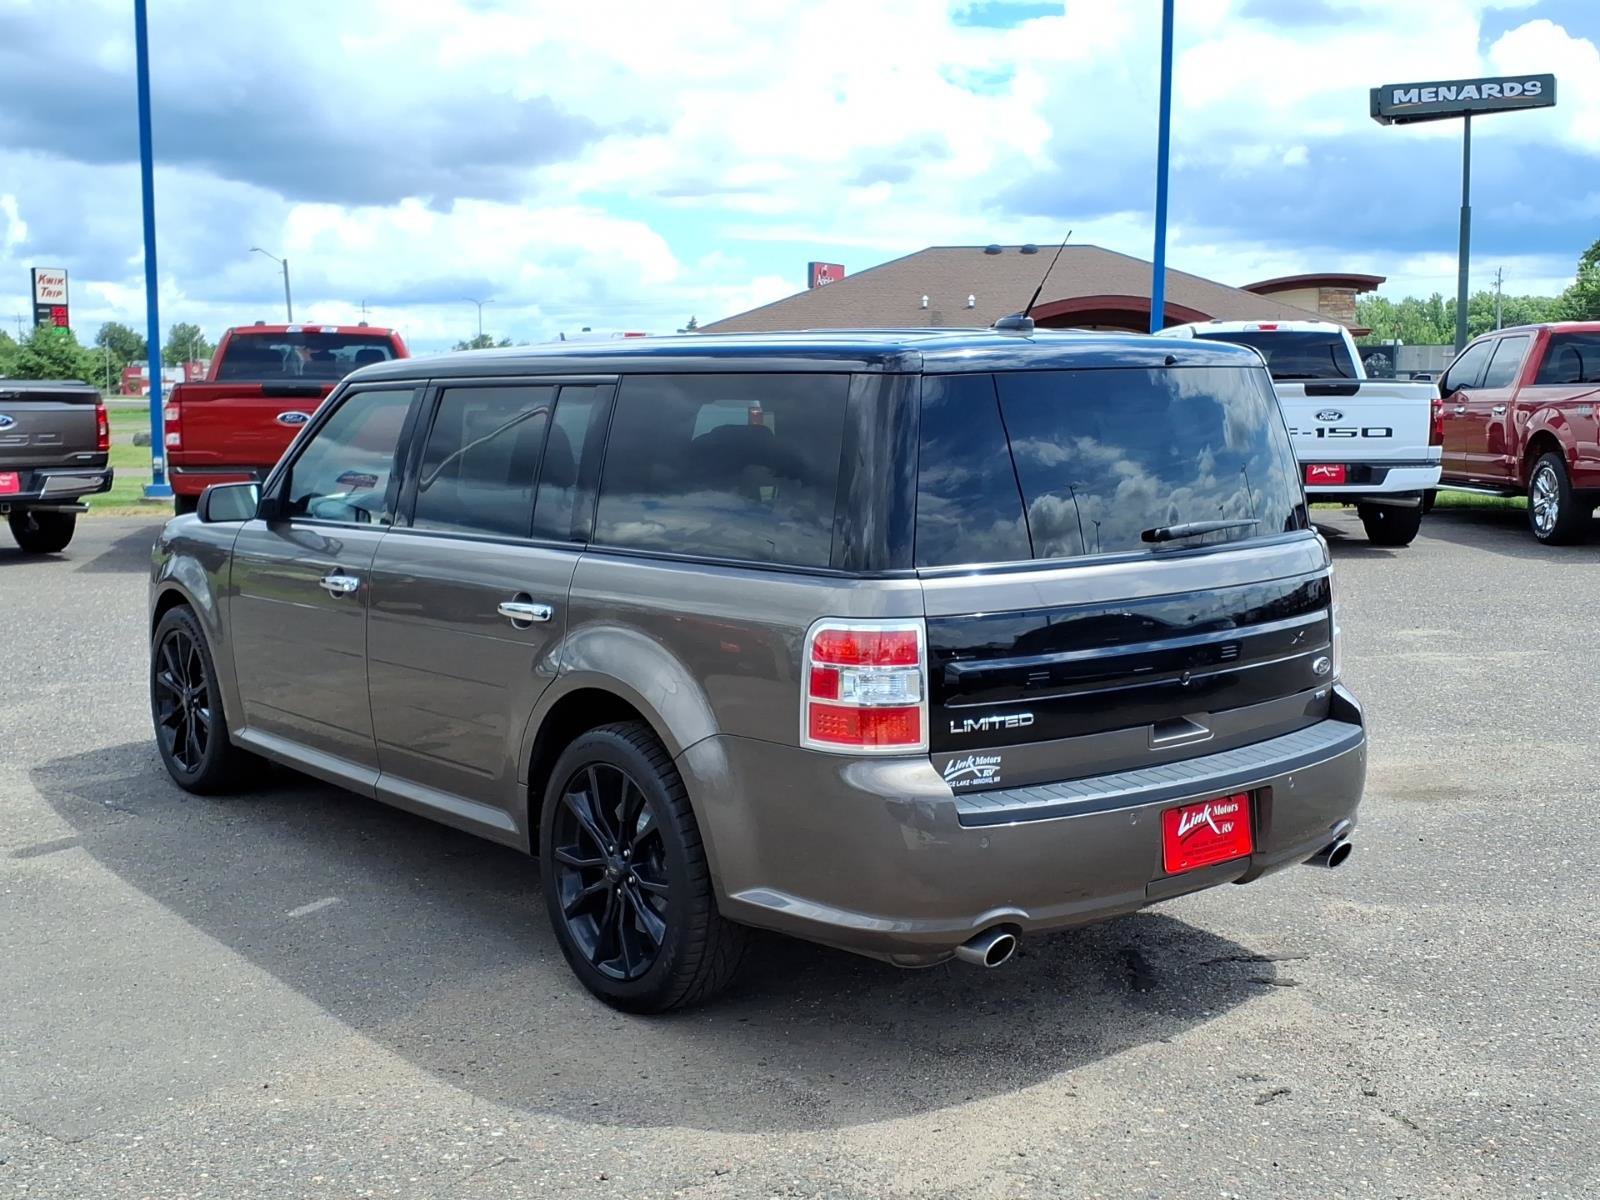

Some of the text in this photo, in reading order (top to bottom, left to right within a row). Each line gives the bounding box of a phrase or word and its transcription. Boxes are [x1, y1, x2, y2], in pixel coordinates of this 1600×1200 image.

[1393, 81, 1542, 104] MENARDS
[1319, 410, 1340, 421] Ford
[950, 713, 1034, 734] LIMITED
[944, 756, 1001, 777] Link Motors
[1178, 803, 1239, 837] Link Motors
[1221, 821, 1235, 834] RV
